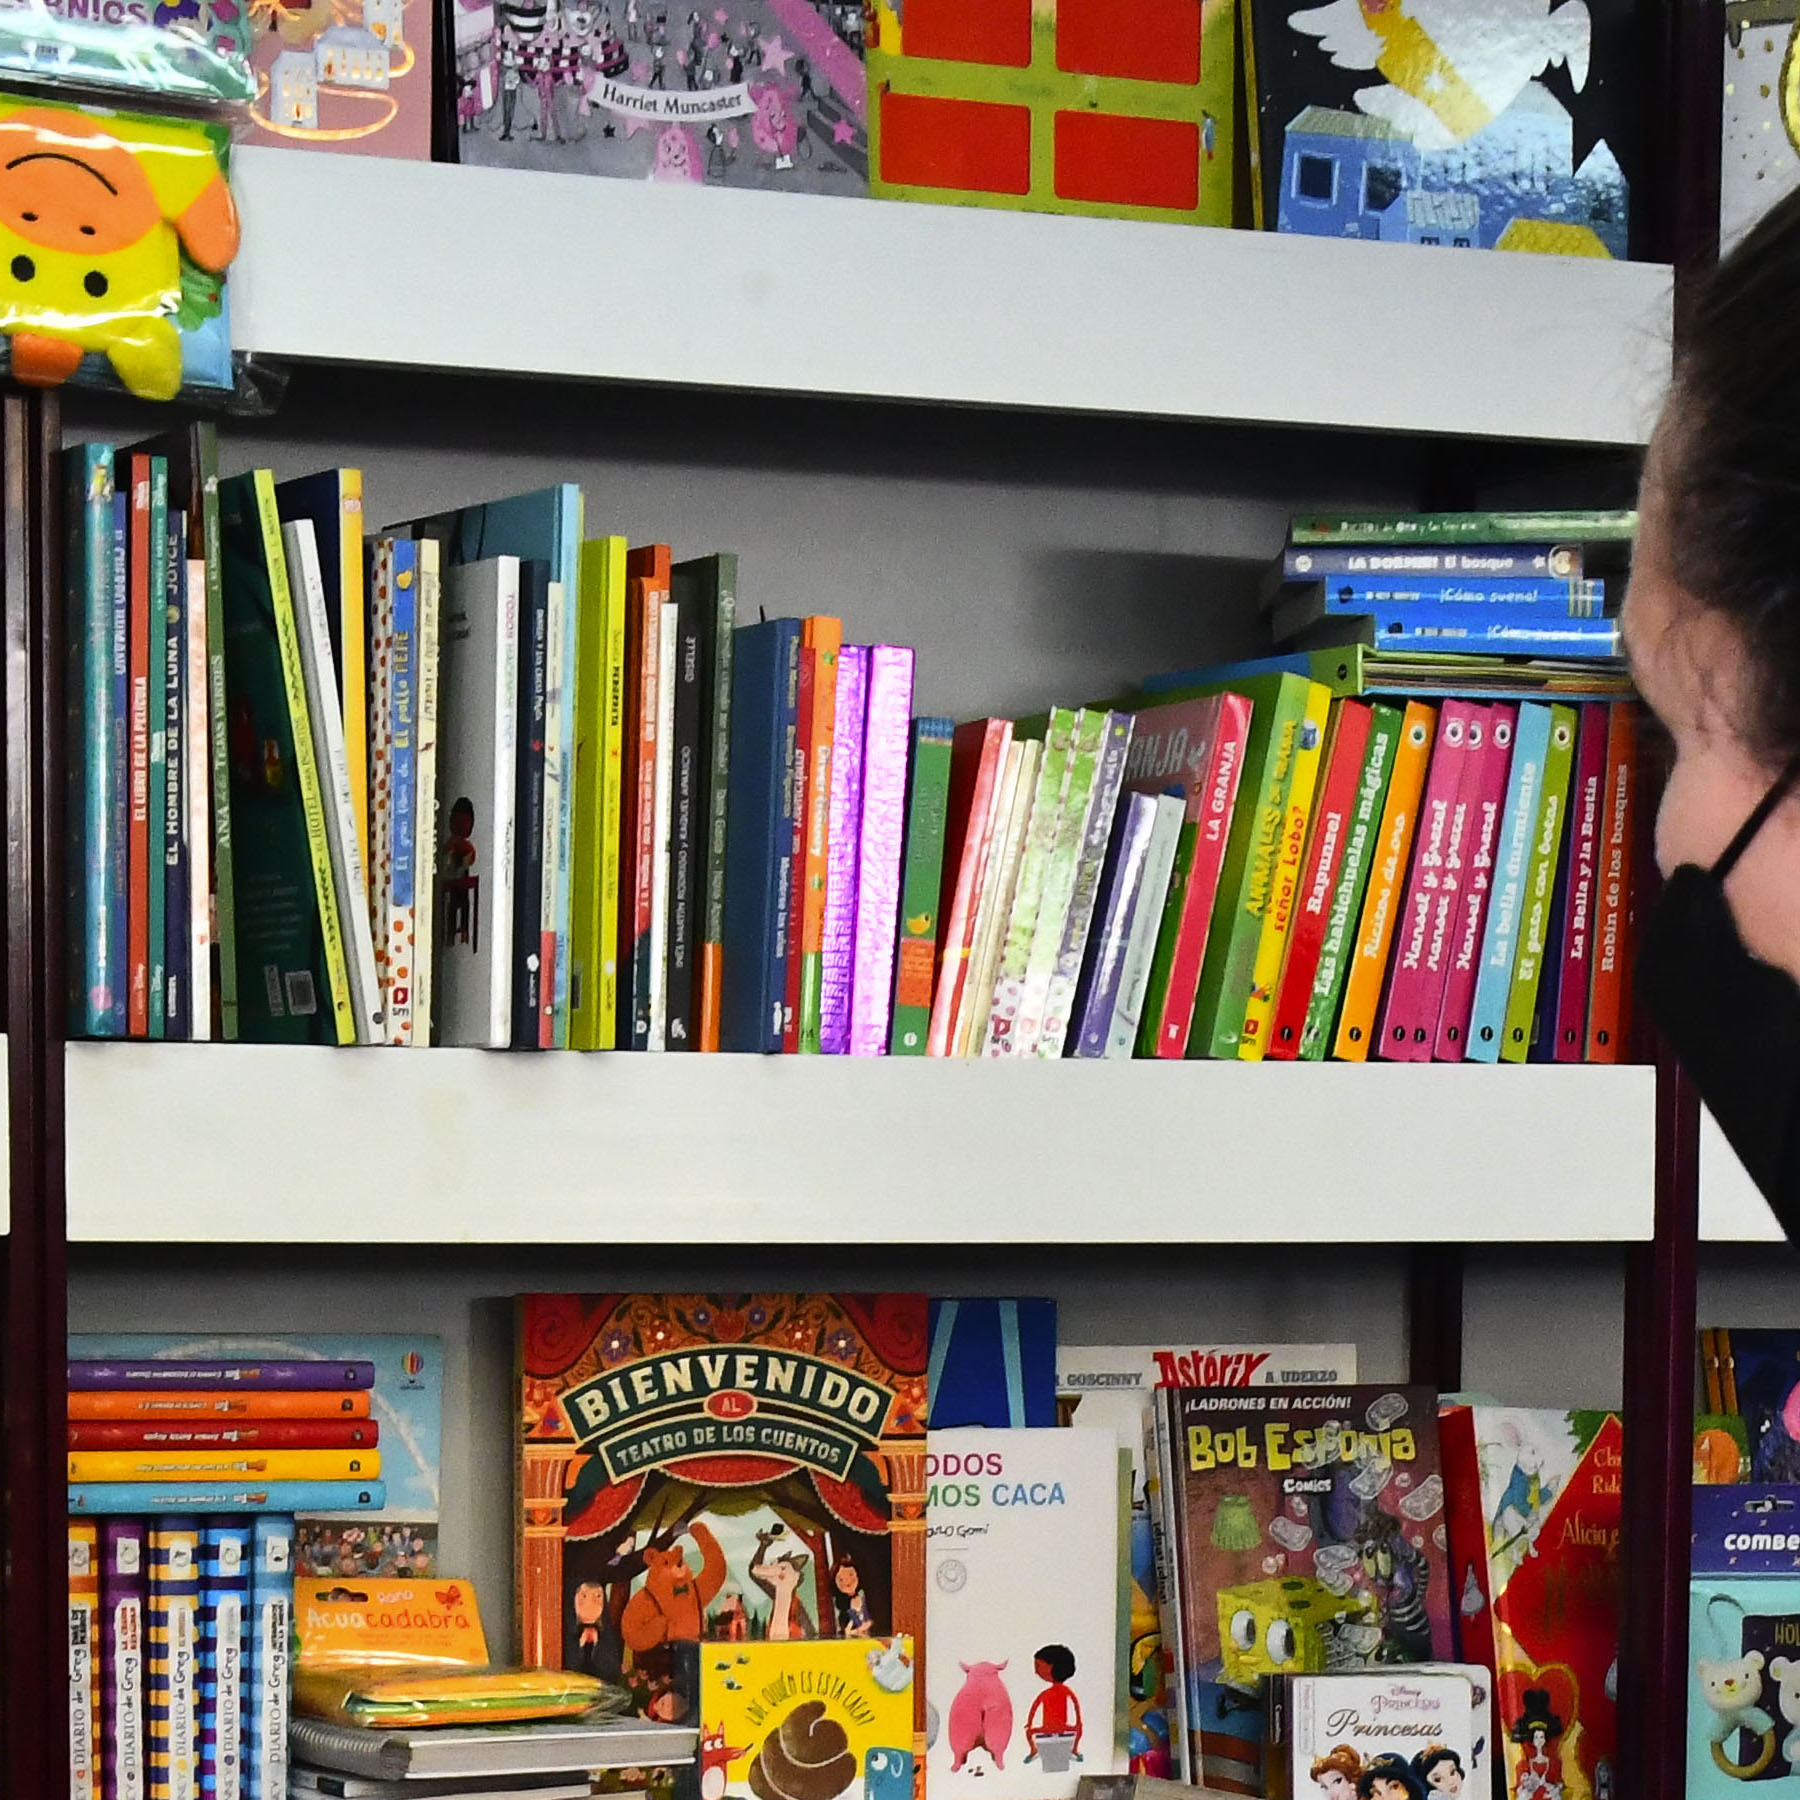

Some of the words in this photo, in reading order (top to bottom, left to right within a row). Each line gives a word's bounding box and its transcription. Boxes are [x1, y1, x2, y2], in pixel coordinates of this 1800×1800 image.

[602, 83, 660, 112] Harriet
[664, 92, 743, 116] Muncaster
[166, 636, 179, 688] LUNA
[166, 695, 179, 719] LA
[166, 740, 179, 762] DE
[1211, 740, 1237, 812] GRANJA
[1358, 732, 1388, 822] mágicas
[166, 765, 179, 834] HOMBRE
[1581, 776, 1597, 837] Bestia
[1612, 764, 1627, 844] bosques
[1206, 819, 1222, 841] LA
[1496, 881, 1518, 935] bella
[1507, 762, 1536, 877] durmiente
[166, 843, 179, 866] EL
[1274, 871, 1290, 932] señor
[1284, 806, 1305, 865] Lobo?
[1580, 842, 1592, 860] la
[1608, 849, 1621, 879] los
[1325, 823, 1366, 951] habichuelas
[1580, 864, 1592, 878] y
[1573, 882, 1588, 929] Bella
[1607, 881, 1620, 908] de
[1403, 892, 1430, 970] Hansel
[1457, 893, 1481, 970] Hansel
[1602, 912, 1617, 973] Robin
[1571, 940, 1583, 960] La
[1315, 956, 1336, 996] Las
[1068, 1371, 1141, 1387] GOSCINNY
[1153, 1349, 1269, 1388] Astérix
[576, 1353, 882, 1430] BIENVENIDO
[720, 1398, 741, 1413] AL
[1185, 1397, 1265, 1412] ¡LADRONES
[1270, 1397, 1288, 1410] EN
[1294, 1396, 1351, 1410] ACCIÓN!
[617, 1428, 686, 1468] TEATRO
[692, 1427, 717, 1444] DE
[724, 1425, 755, 1444] LOS
[762, 1428, 842, 1465] CUENTOS
[1188, 1424, 1257, 1471] Bob
[1267, 1422, 1414, 1471] Esponja
[993, 1483, 1066, 1505] CACA
[307, 1608, 470, 1629] Acuacadabra
[70, 1648, 86, 1683] Greg
[121, 1657, 137, 1691] Greg
[174, 1651, 191, 1683] Greg
[221, 1647, 237, 1679] Greg
[267, 1654, 284, 1688] Greg
[816, 1671, 846, 1698] ESTA
[124, 1712, 136, 1766] DIARIO
[174, 1703, 187, 1756] DIARIO
[223, 1698, 234, 1751] DIARIO
[269, 1709, 281, 1763] DIARIO
[1327, 1708, 1442, 1738] Princesas
